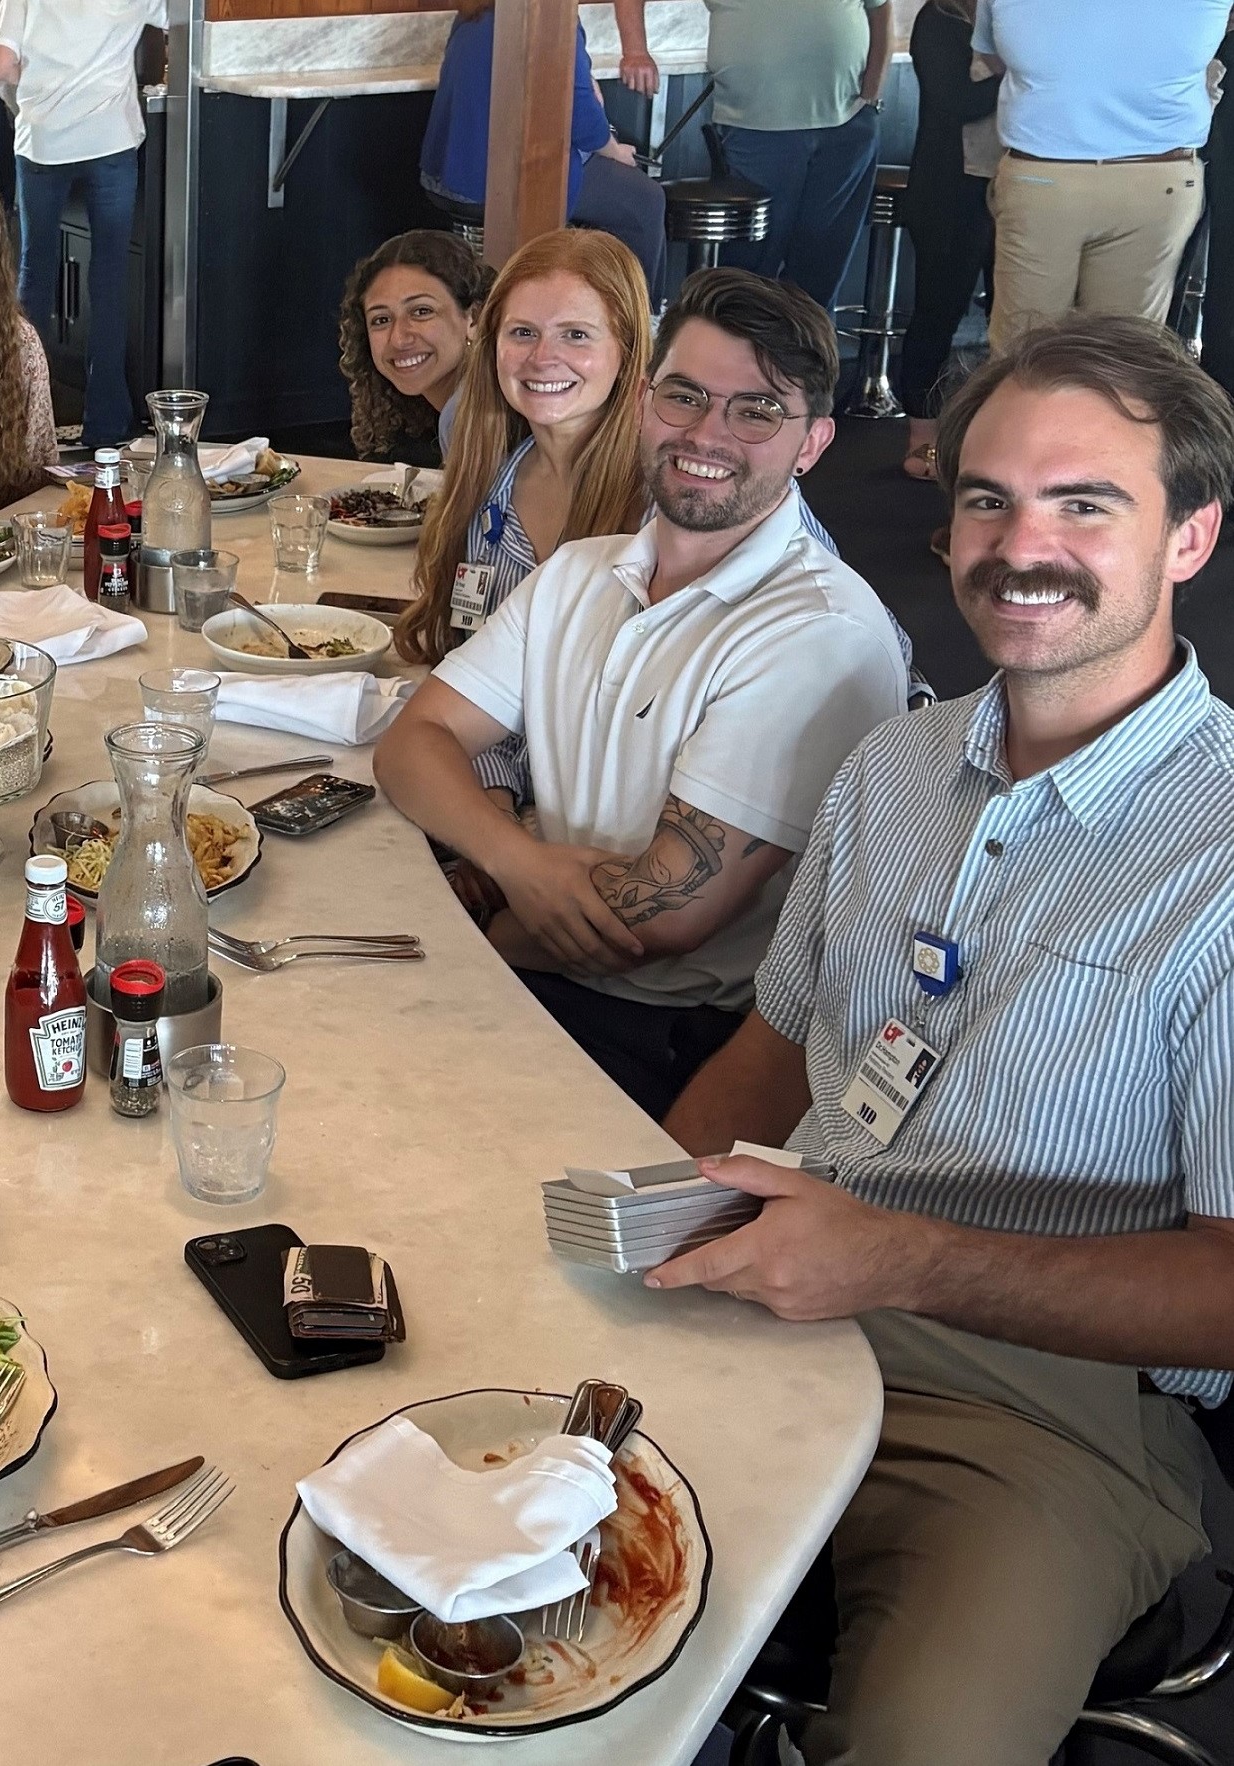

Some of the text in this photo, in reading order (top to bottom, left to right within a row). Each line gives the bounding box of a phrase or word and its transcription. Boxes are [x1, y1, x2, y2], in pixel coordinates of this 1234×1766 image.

[53, 900, 65, 912] 57
[51, 1017, 82, 1034] HEINZ
[50, 1032, 83, 1048] TOMATO
[291, 1275, 311, 1294] 50
